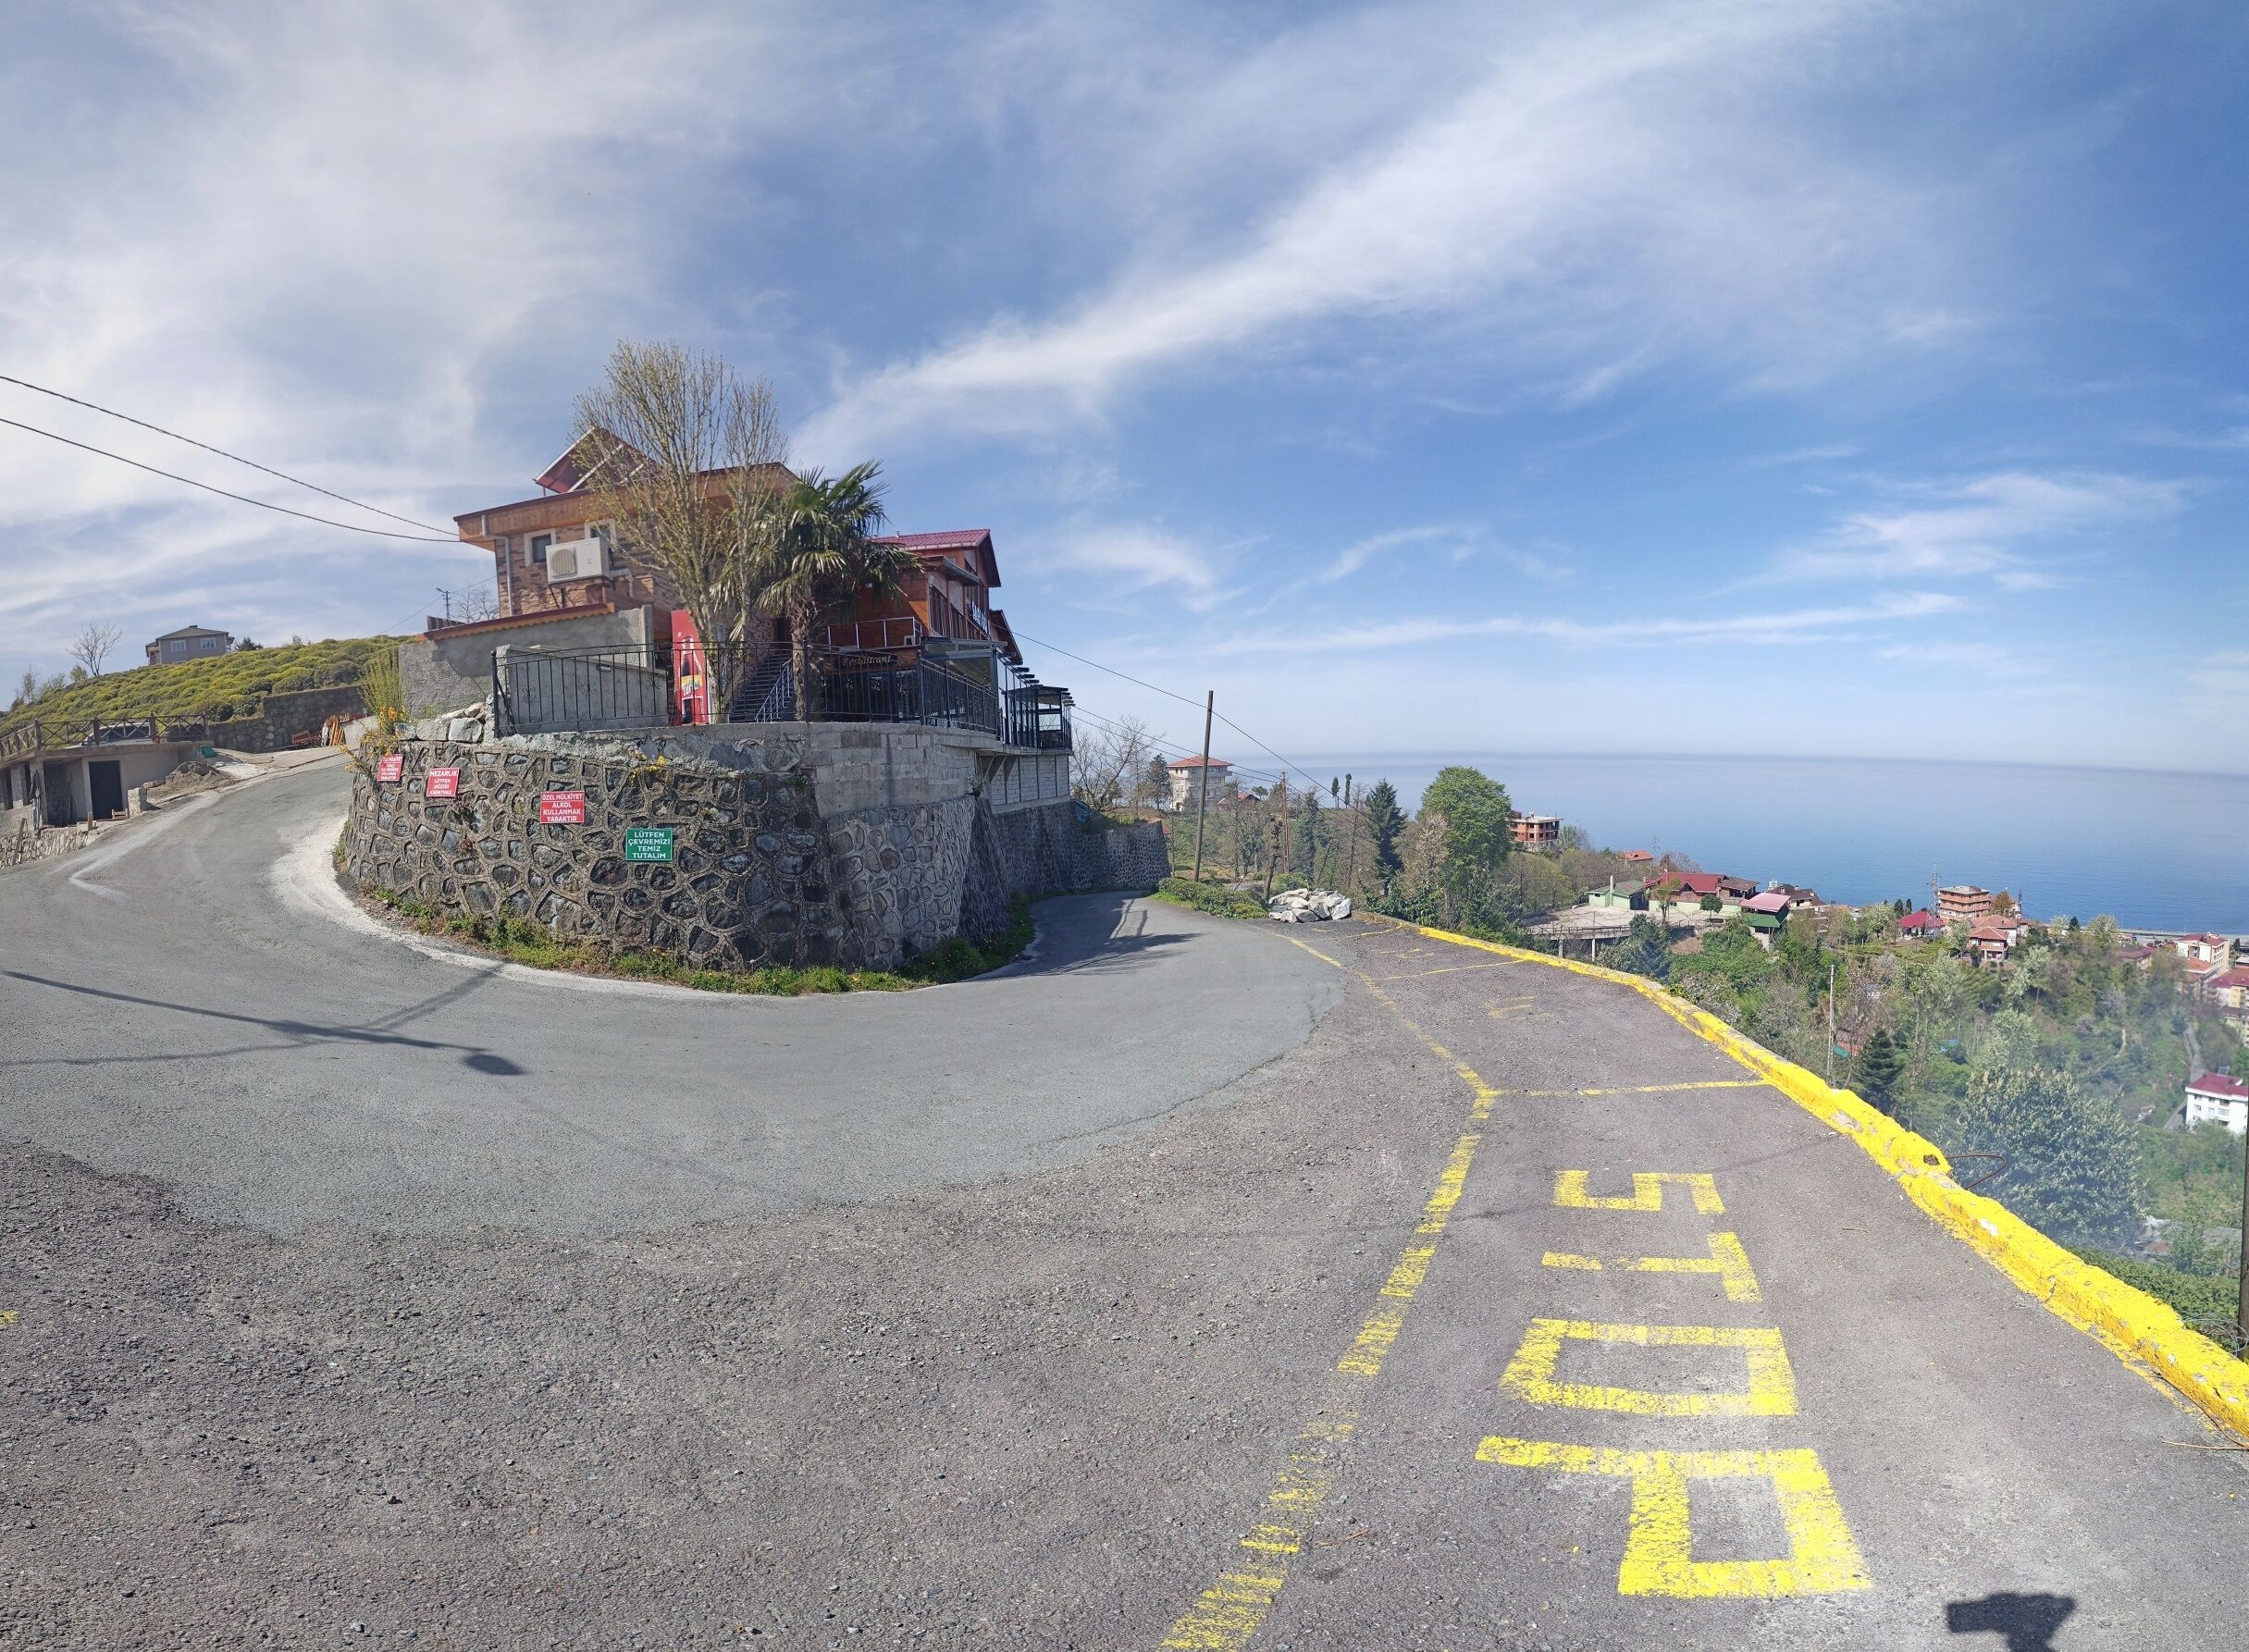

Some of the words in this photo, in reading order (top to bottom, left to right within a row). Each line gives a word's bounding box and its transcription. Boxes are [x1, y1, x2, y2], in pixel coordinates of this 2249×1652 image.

[842, 655, 891, 666] Restaurant
[556, 792, 583, 800] MÜLKİYET
[634, 830, 665, 838] LÜTFEN
[628, 838, 671, 846] ÇEVREMİZİ
